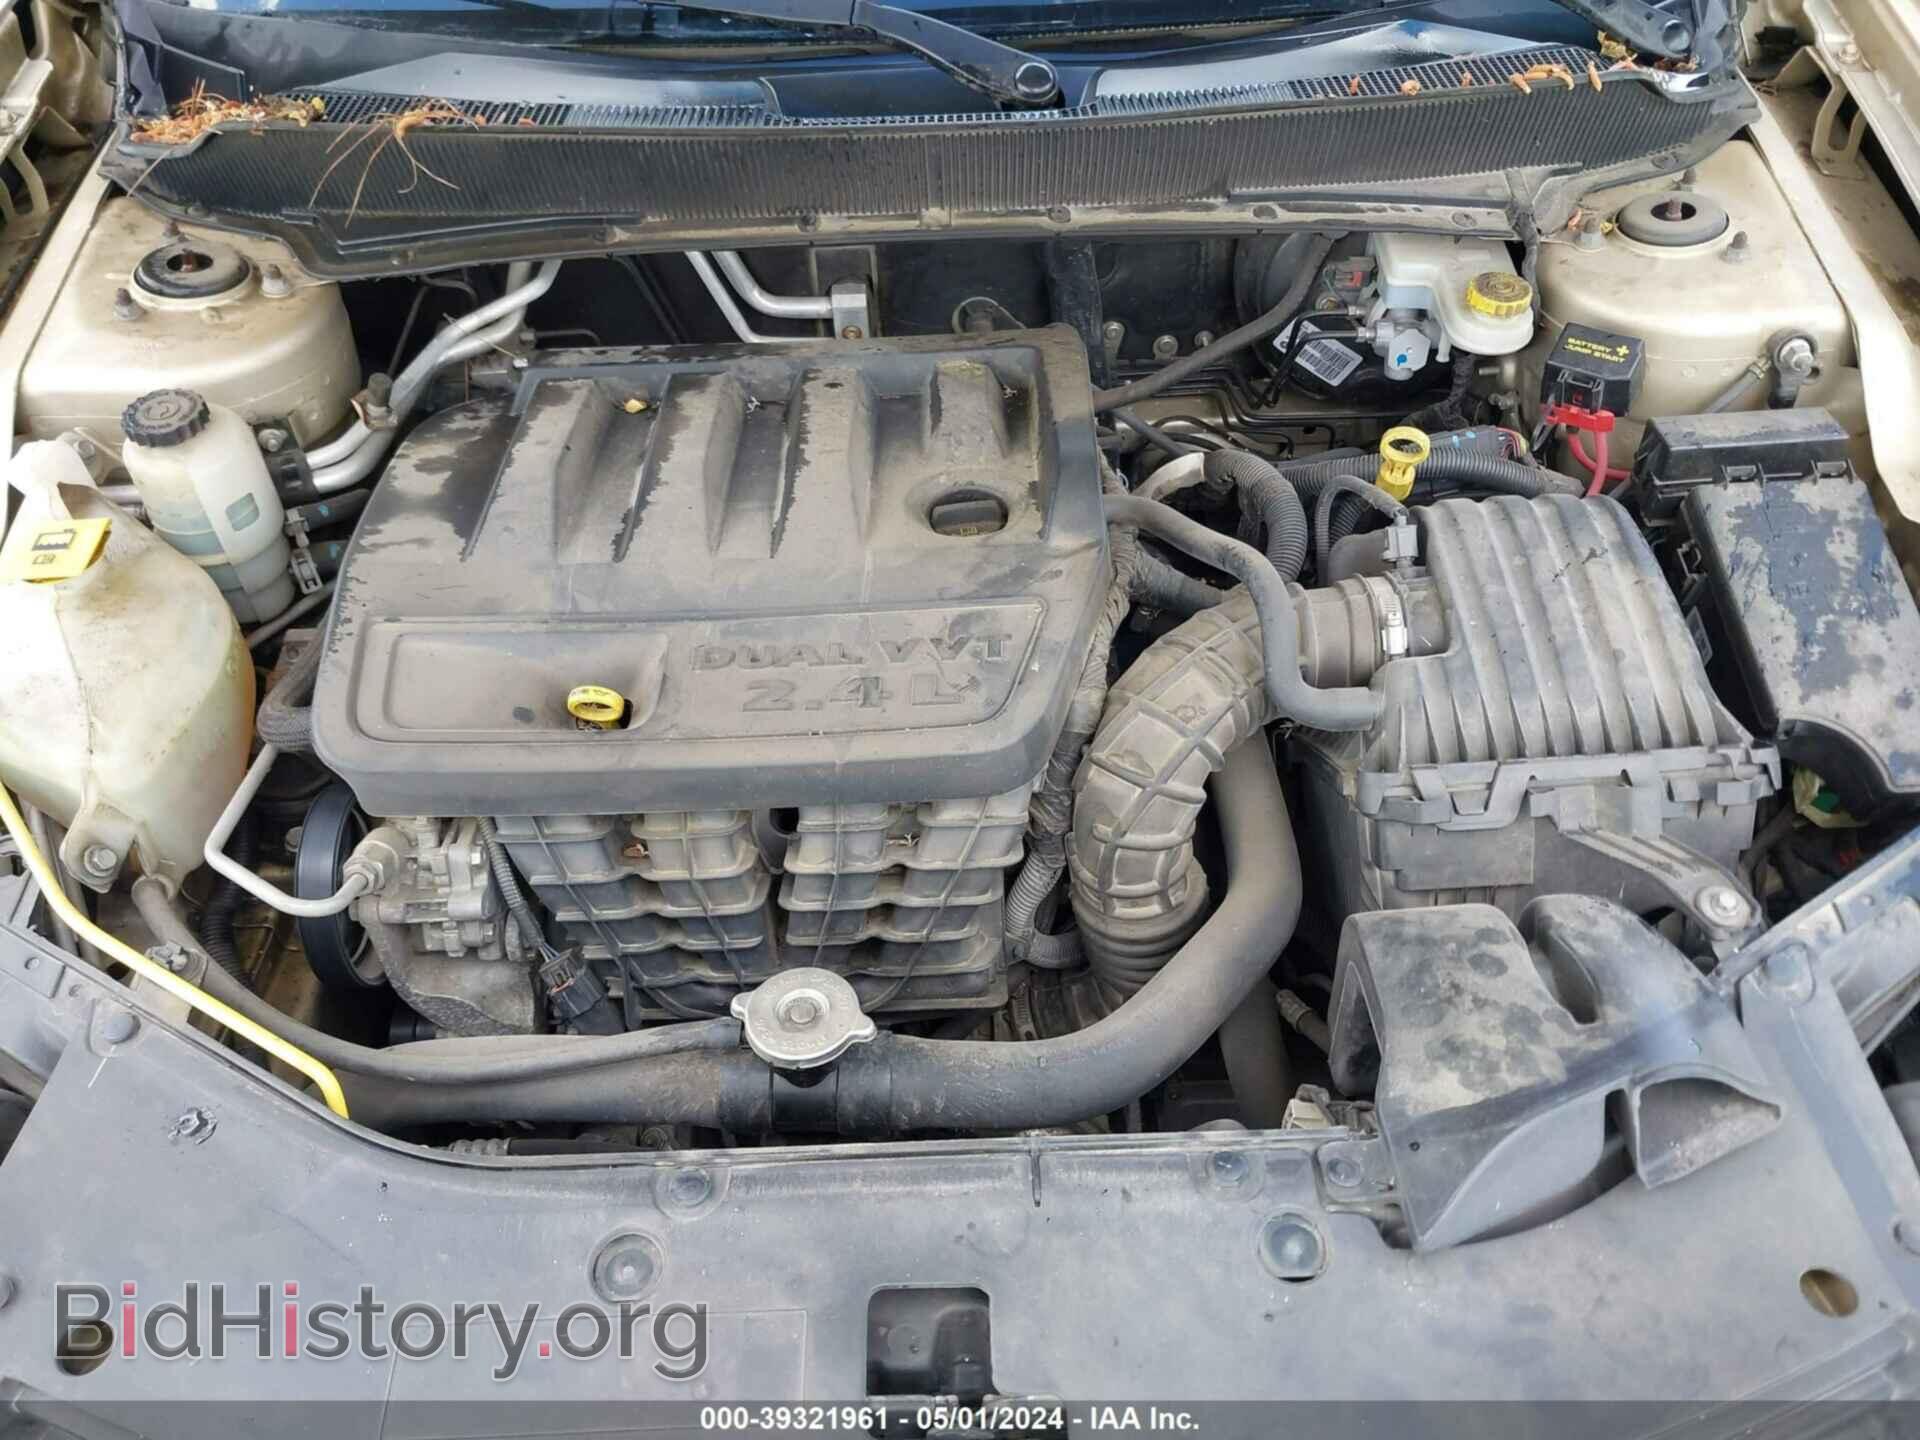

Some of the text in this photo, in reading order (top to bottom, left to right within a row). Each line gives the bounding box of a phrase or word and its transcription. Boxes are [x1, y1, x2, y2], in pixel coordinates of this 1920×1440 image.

[1567, 337, 1612, 353] BATTERY
[1593, 351, 1626, 363] START
[692, 634, 1013, 671] DUAL VVT
